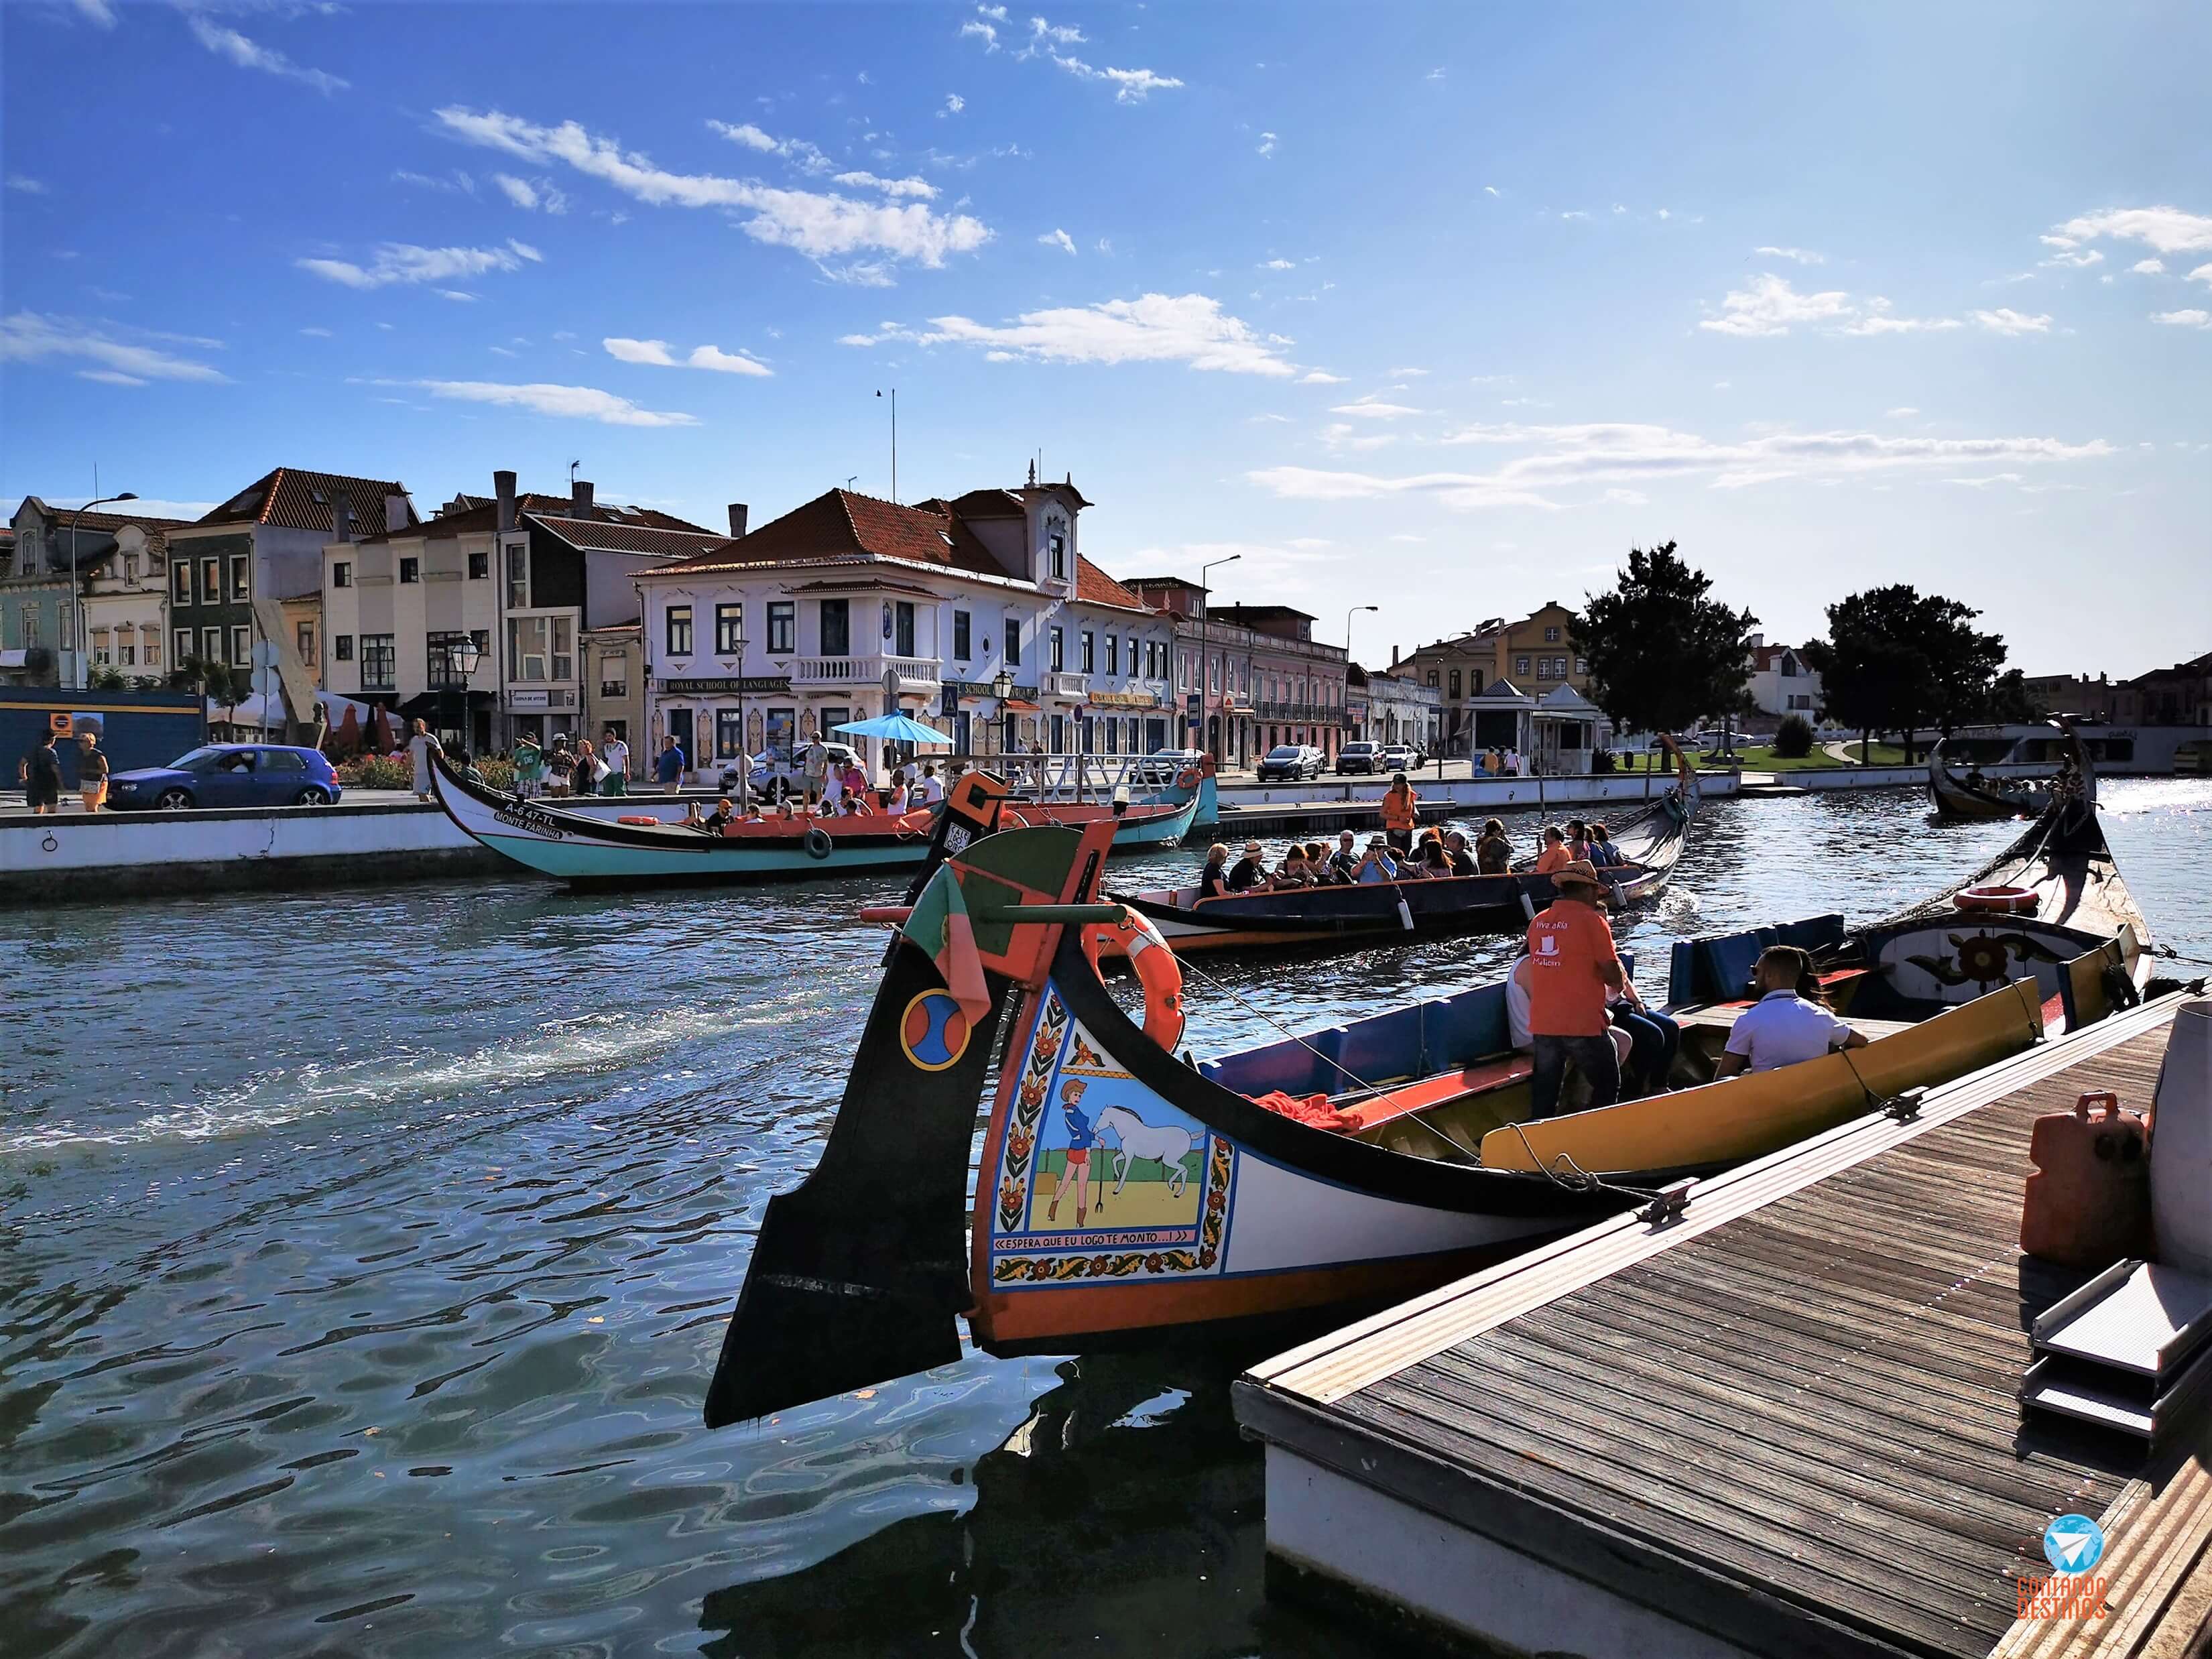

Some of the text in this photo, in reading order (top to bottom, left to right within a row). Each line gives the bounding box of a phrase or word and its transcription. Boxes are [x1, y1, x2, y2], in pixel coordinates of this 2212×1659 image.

[670, 681, 694, 690] ROYAL
[696, 680, 727, 690] SCHOOL
[743, 680, 789, 689] LANGUAGES
[965, 684, 991, 695] SCHOOL
[495, 812, 560, 839] MONTE FARINHA
[1043, 1235, 1062, 1246] QUE
[1064, 1235, 1077, 1245] EU
[1081, 1234, 1105, 1245] LOGO
[1106, 1233, 1118, 1243] TE
